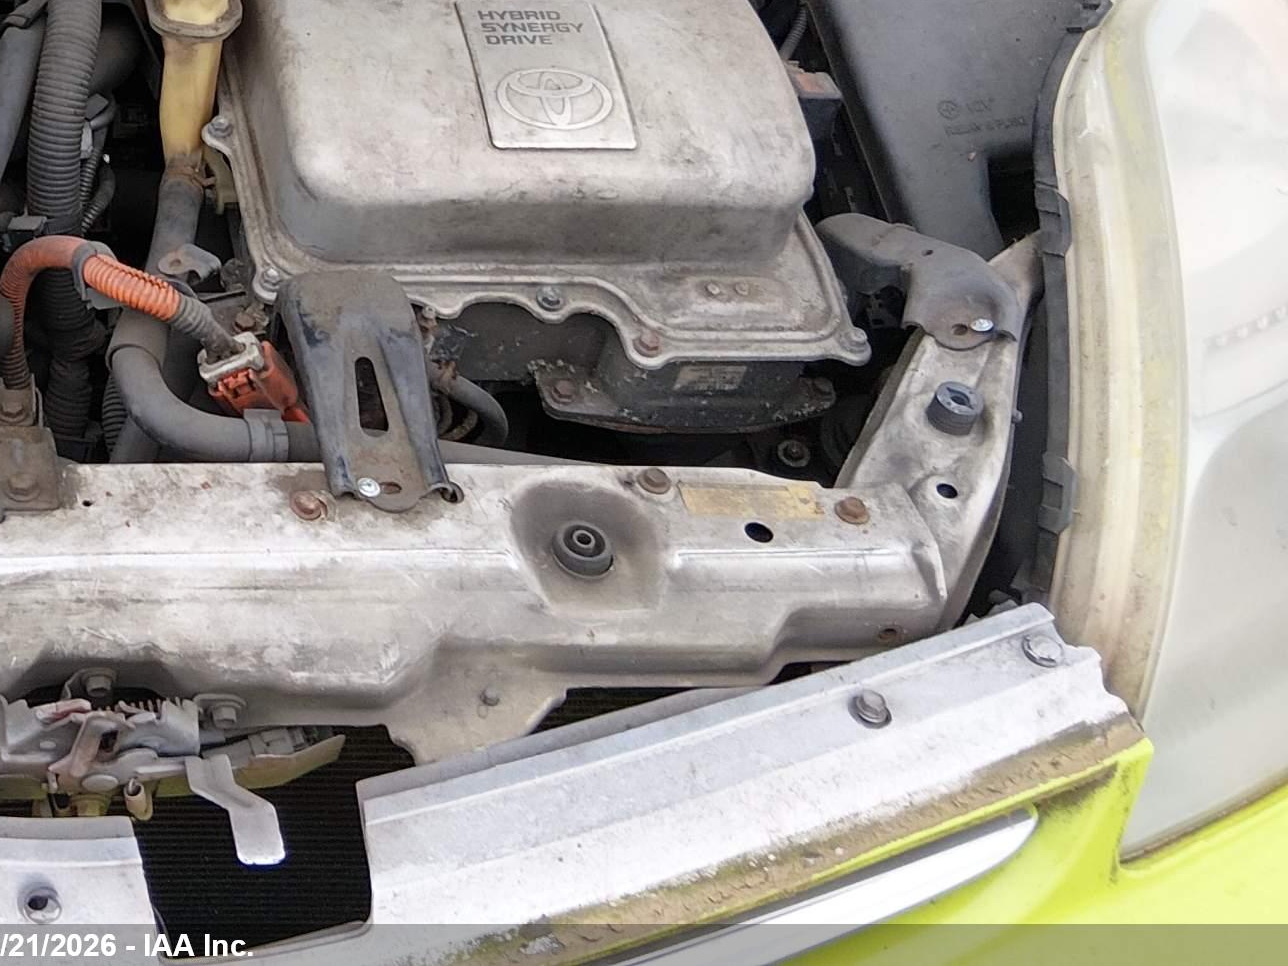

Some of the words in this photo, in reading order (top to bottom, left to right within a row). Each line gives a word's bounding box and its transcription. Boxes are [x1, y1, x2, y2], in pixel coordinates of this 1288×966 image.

[477, 9, 561, 21] HYBRID
[481, 22, 584, 33] SYNERGY
[486, 34, 554, 45] DRIVE
